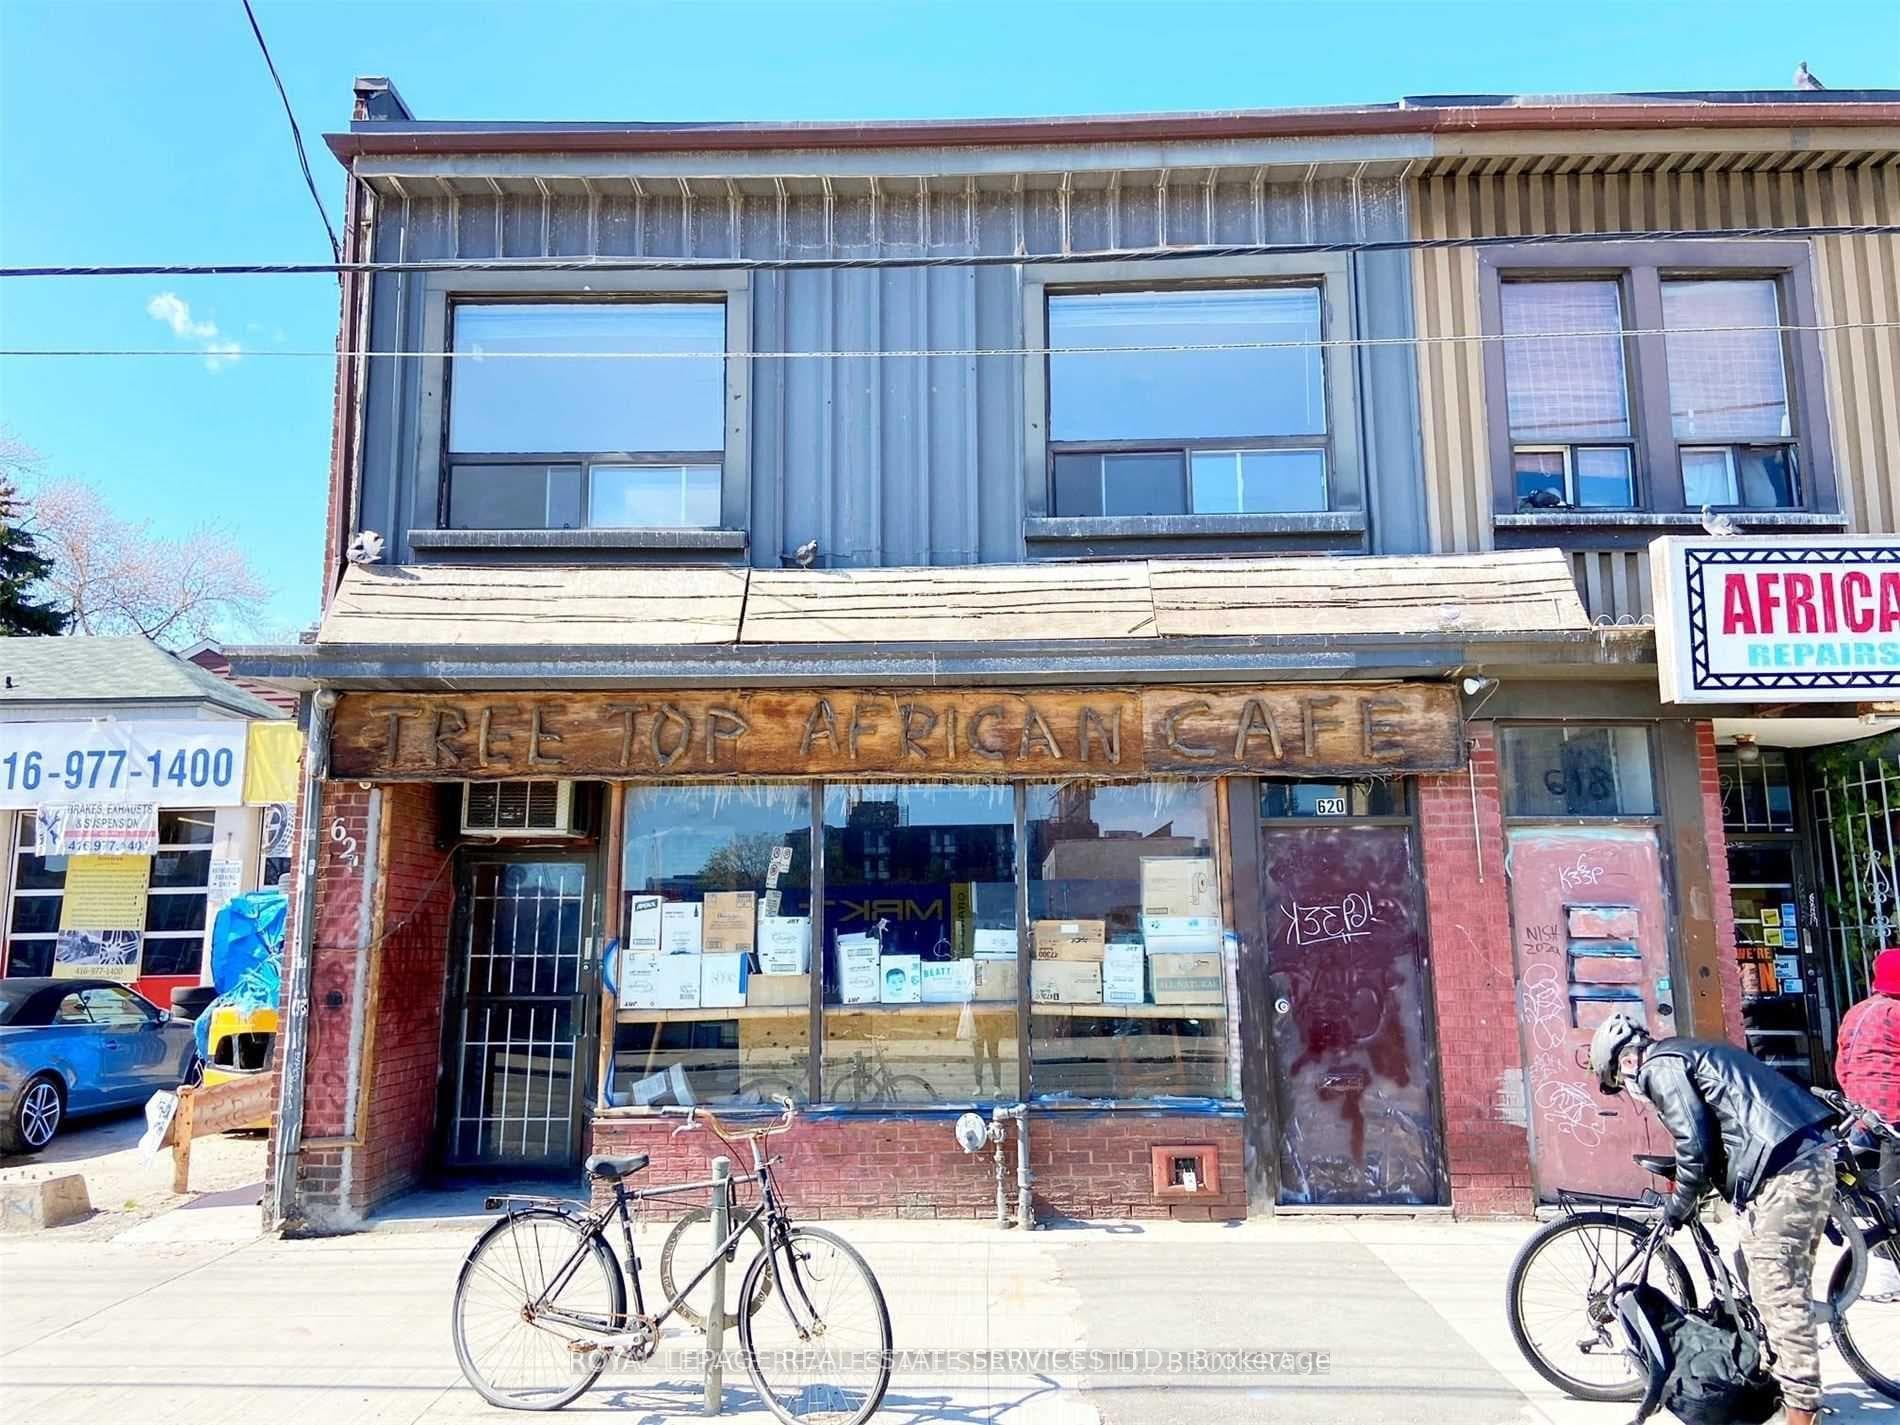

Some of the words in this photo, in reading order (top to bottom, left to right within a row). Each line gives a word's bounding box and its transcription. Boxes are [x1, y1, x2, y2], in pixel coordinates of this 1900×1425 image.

[1723, 571, 1900, 635] AFRICA
[1748, 641, 1900, 668] REPAIRS
[605, 702, 750, 768] TOP
[800, 697, 1121, 765] AFRICAN
[1164, 696, 1405, 760] CAFE
[3, 748, 233, 790] 16-977-1400
[1317, 800, 1345, 814] 620
